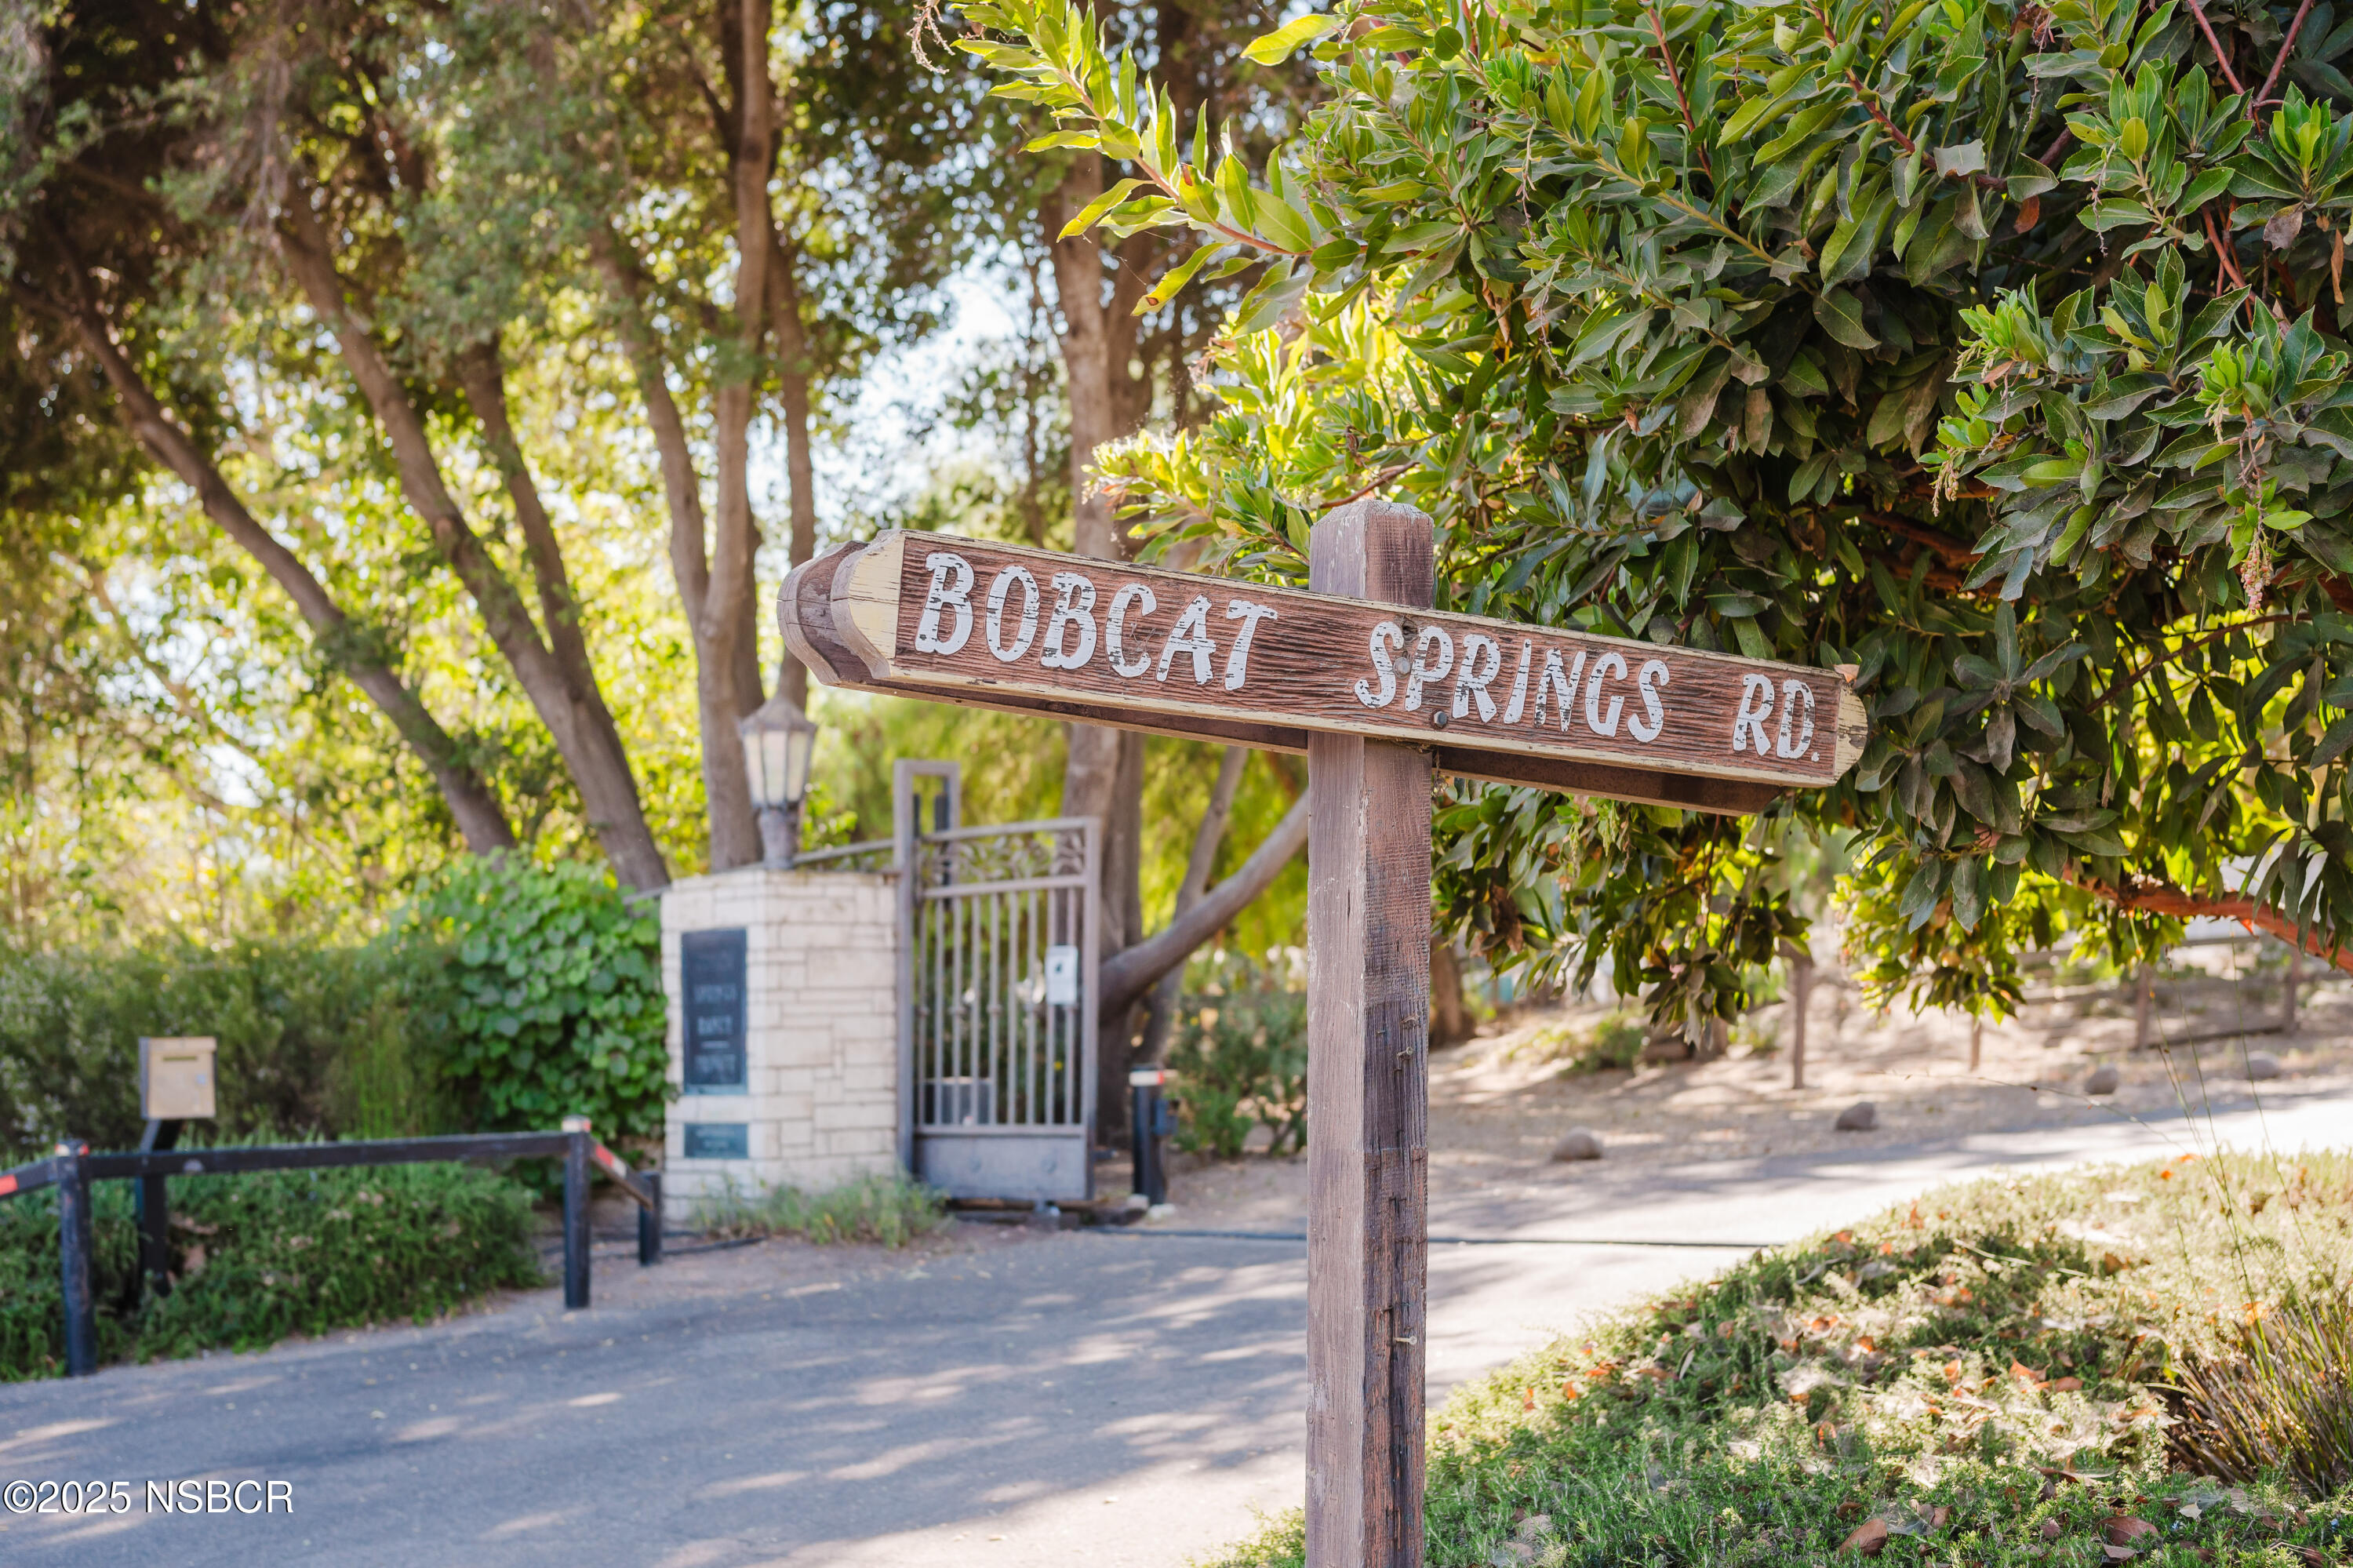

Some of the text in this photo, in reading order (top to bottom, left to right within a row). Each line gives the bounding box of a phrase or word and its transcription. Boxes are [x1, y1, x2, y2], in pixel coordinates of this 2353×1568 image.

[914, 551, 1820, 762] BOBCAT SPRINGS RD.
